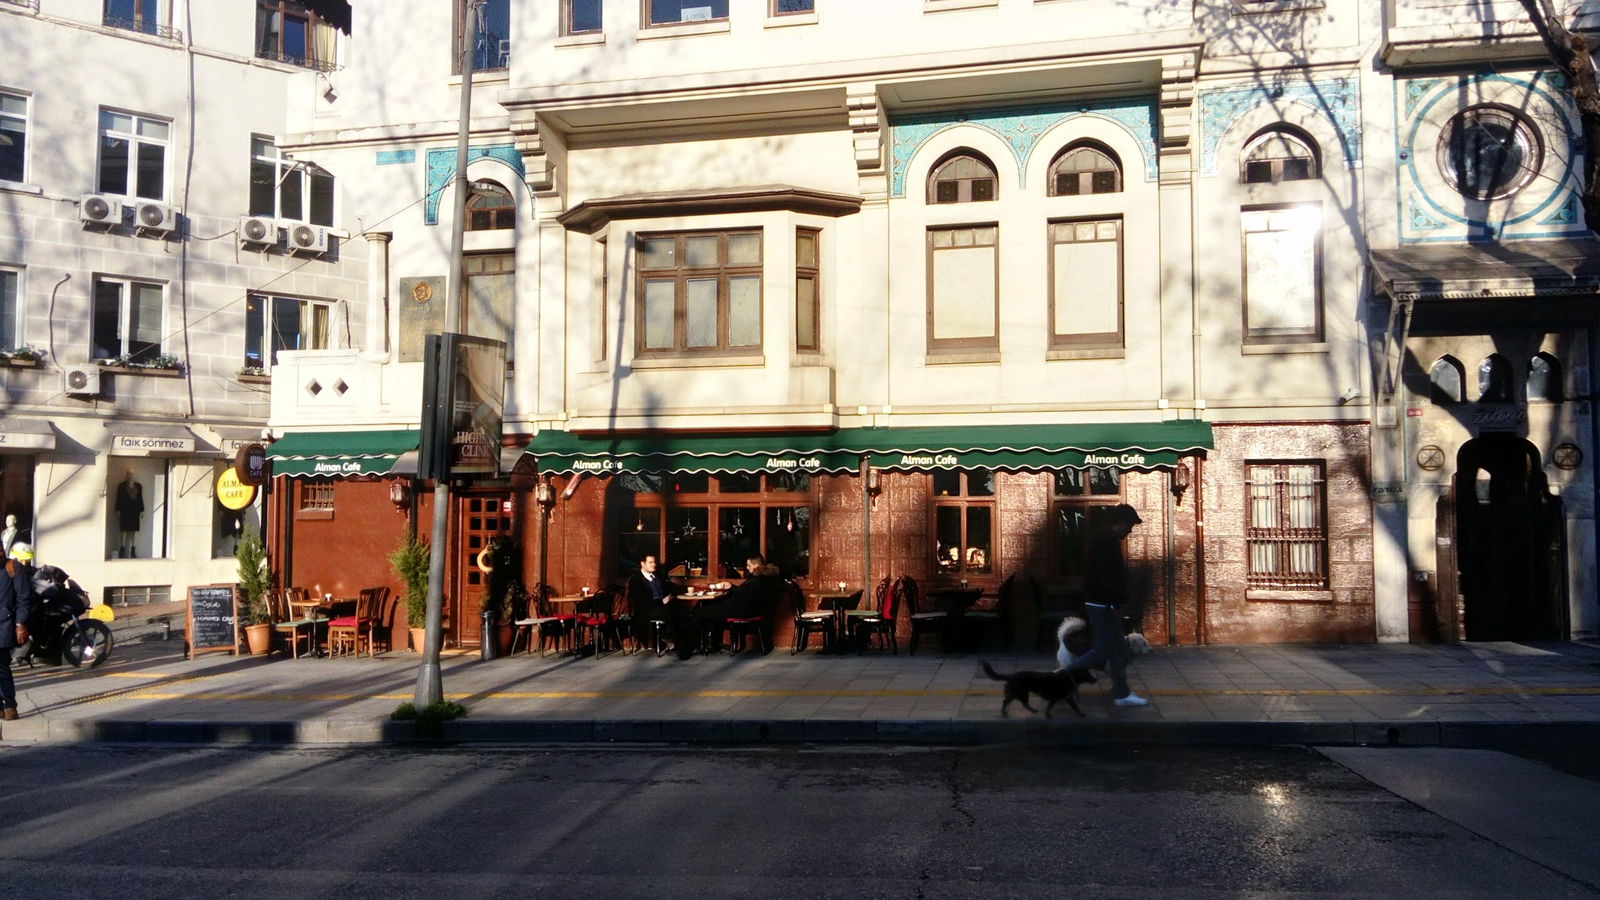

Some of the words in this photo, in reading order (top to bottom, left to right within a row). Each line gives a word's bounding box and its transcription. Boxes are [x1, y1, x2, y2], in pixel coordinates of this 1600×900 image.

[142, 437, 184, 449] sönmez
[572, 460, 602, 470] Alman
[602, 459, 624, 470] Cafe
[766, 457, 797, 468] Alman
[798, 457, 821, 468] Cafe
[901, 455, 933, 465] Alman
[934, 454, 958, 465] Cafe
[1084, 454, 1119, 464] Alman
[1120, 454, 1145, 465] Cafe
[314, 462, 341, 472] Alman
[342, 461, 362, 472] Cafe
[226, 491, 244, 499] CAFE
